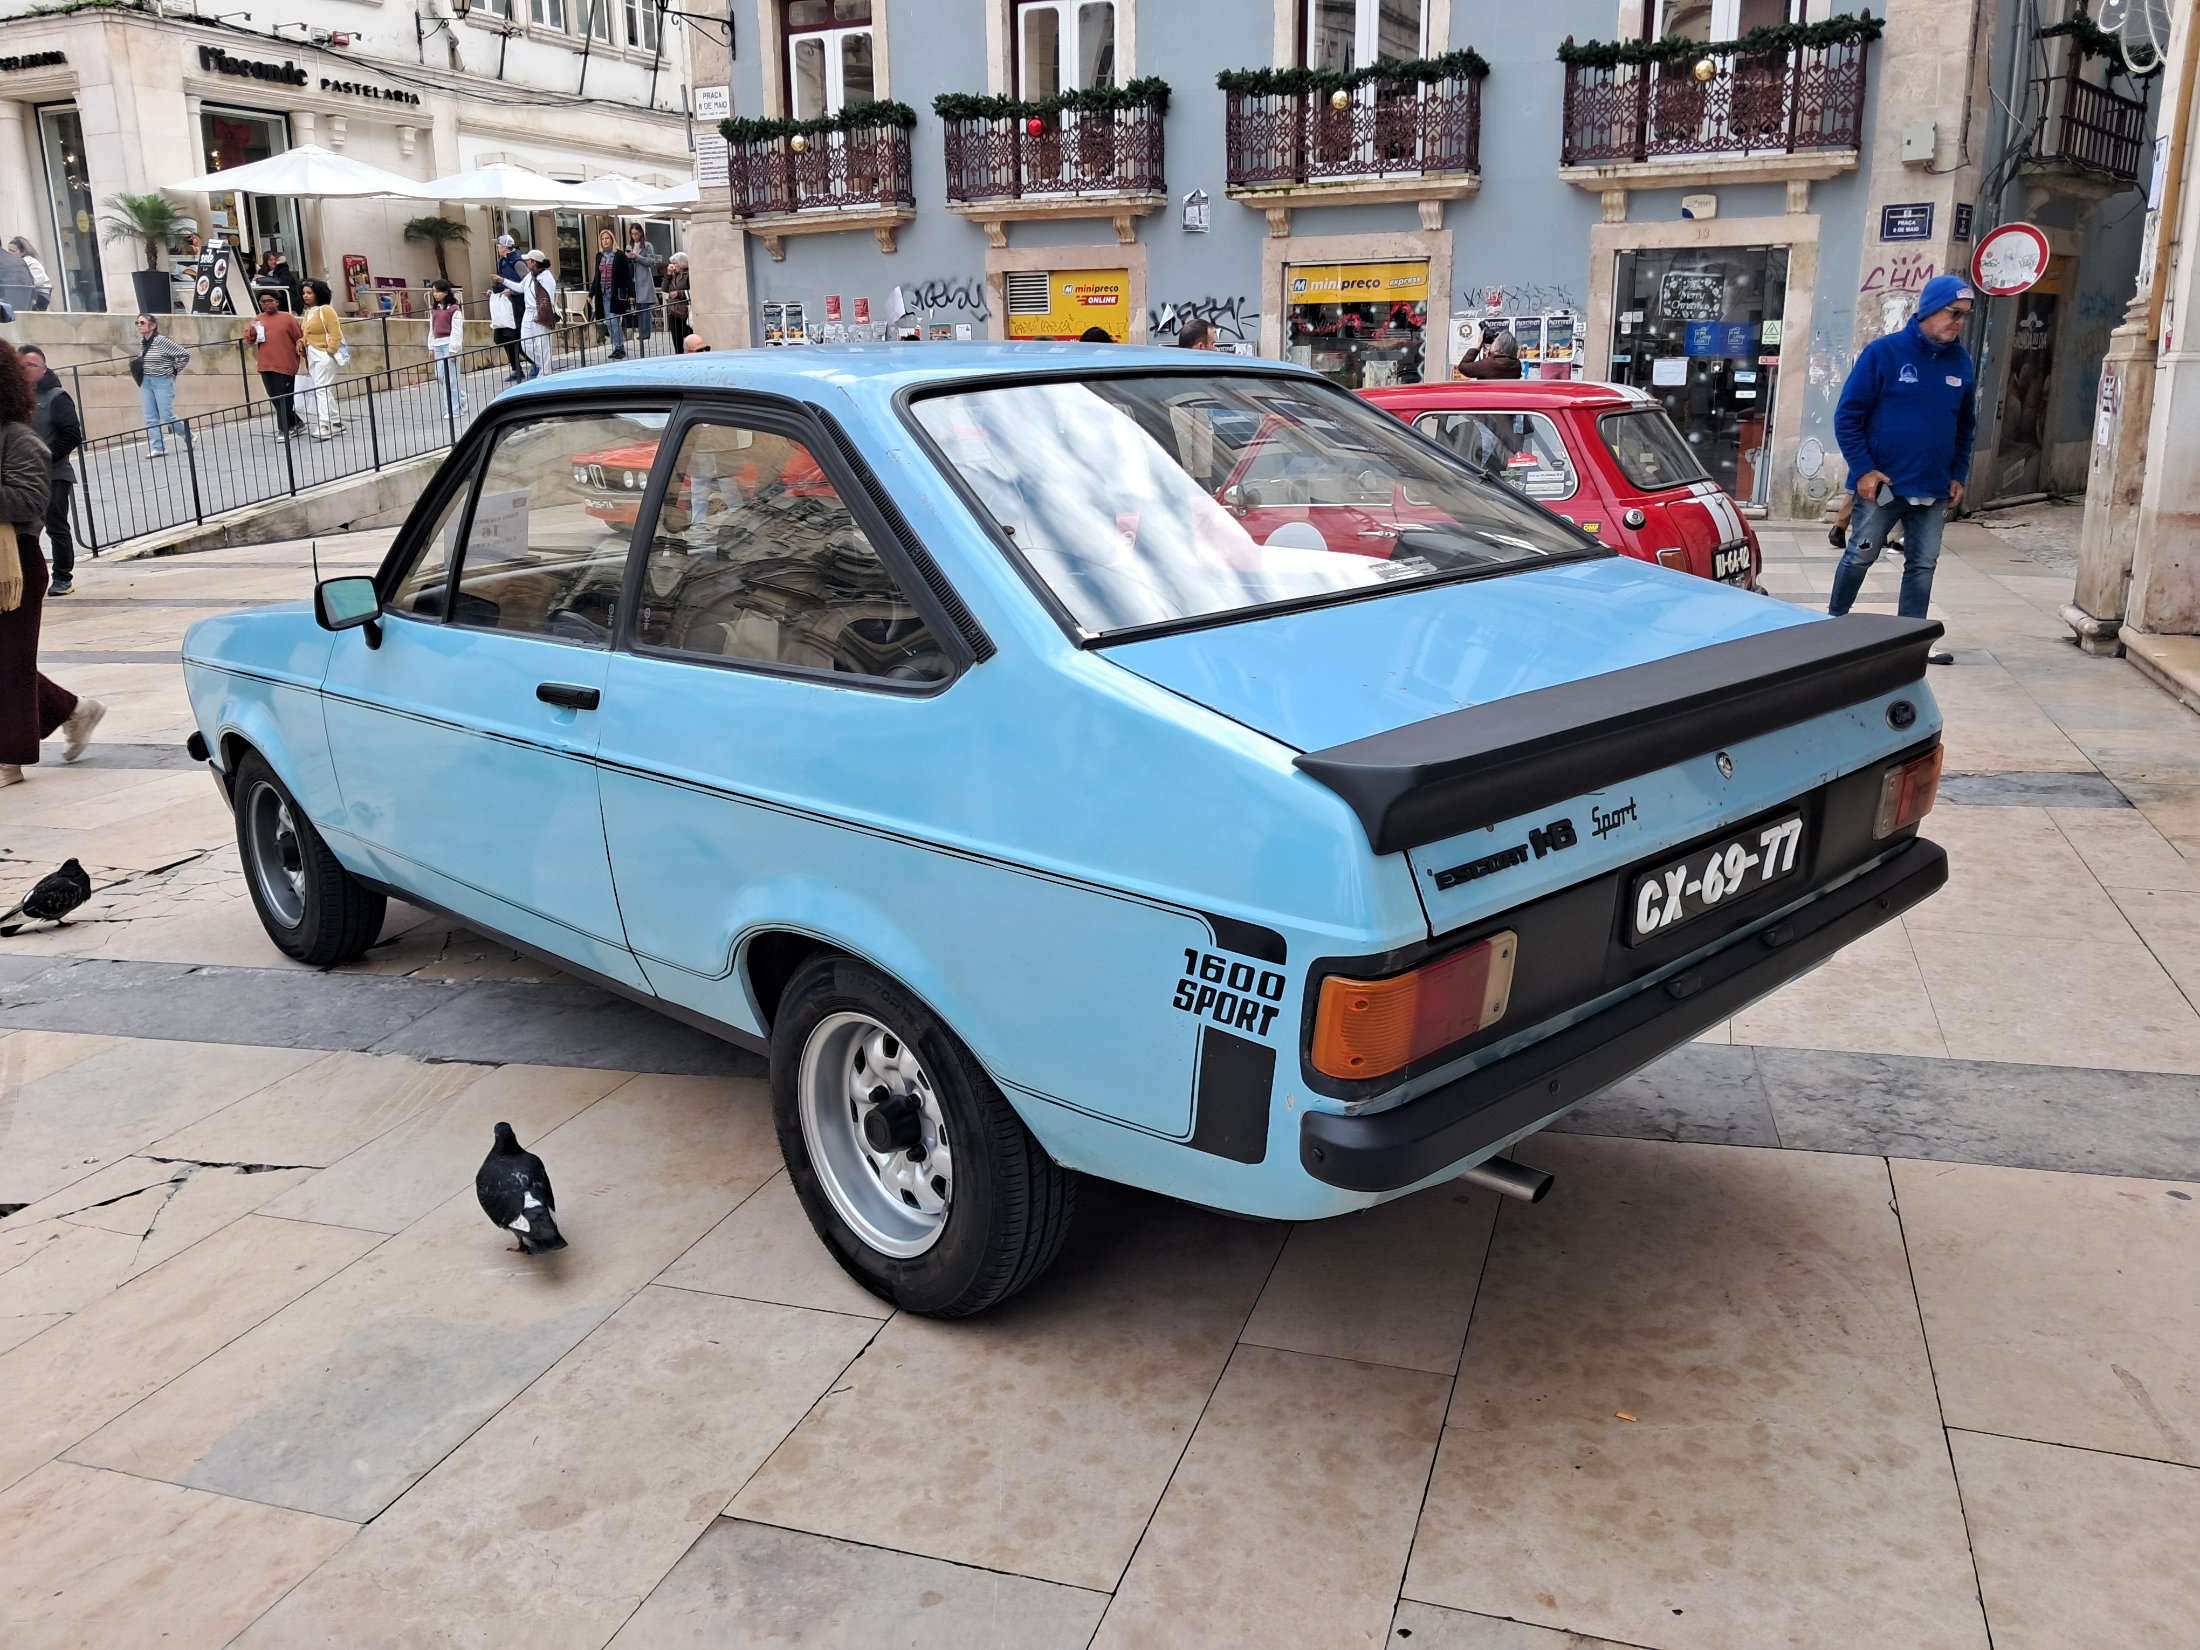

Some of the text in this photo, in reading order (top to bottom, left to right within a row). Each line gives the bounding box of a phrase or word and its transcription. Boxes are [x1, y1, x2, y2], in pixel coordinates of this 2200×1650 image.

[320, 78, 420, 105] PASTELARIA
[1088, 296, 1117, 304] ONLINE
[1310, 278, 1381, 291] minipreço
[1389, 276, 1421, 287] express
[1434, 844, 1528, 891] ESCORT
[1592, 796, 1637, 840] Sport
[1636, 817, 1803, 935] CX-69-77
[1184, 947, 1286, 1001] 1600
[1172, 978, 1280, 1036] SPORT
